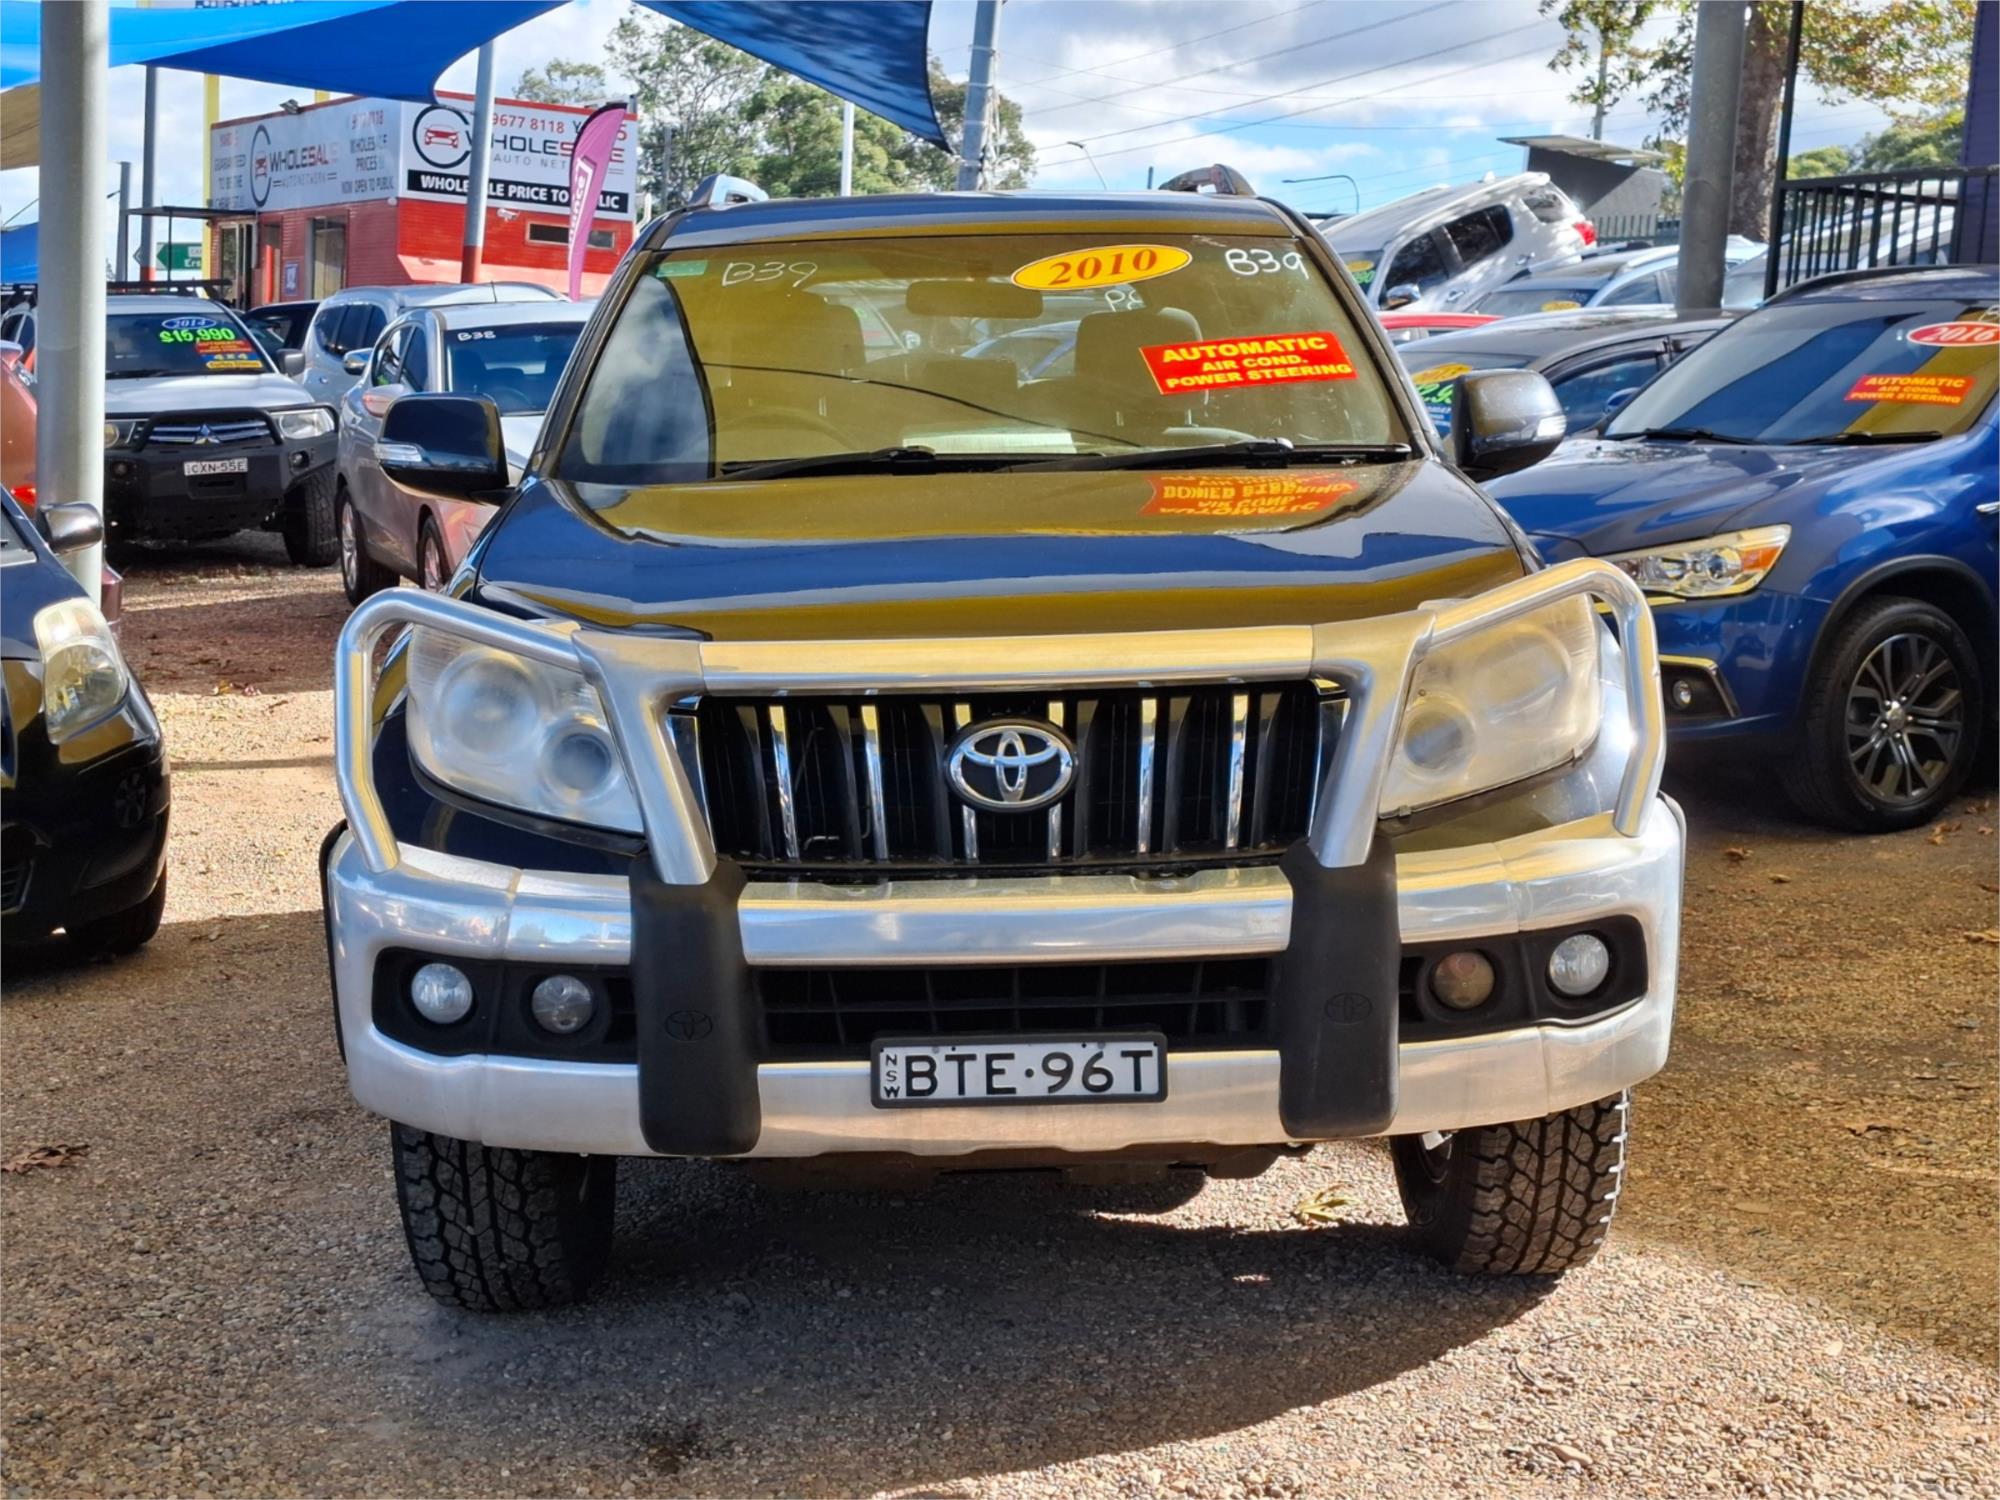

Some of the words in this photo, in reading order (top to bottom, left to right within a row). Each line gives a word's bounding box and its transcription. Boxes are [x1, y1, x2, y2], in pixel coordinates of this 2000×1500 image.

[530, 119, 565, 134] 8118
[508, 184, 548, 201] PRICE
[551, 188, 570, 203] TO
[722, 262, 818, 287] B39
[1048, 249, 1158, 285] 2010
[1918, 327, 1997, 342] 2016
[1163, 337, 1328, 363] AUTOMATIC
[1202, 360, 1239, 372] AIR
[1243, 354, 1309, 368] COND.
[1165, 372, 1244, 388] POWER
[1246, 363, 1352, 381] STEERING
[1863, 377, 1966, 388] AUTOMATIC
